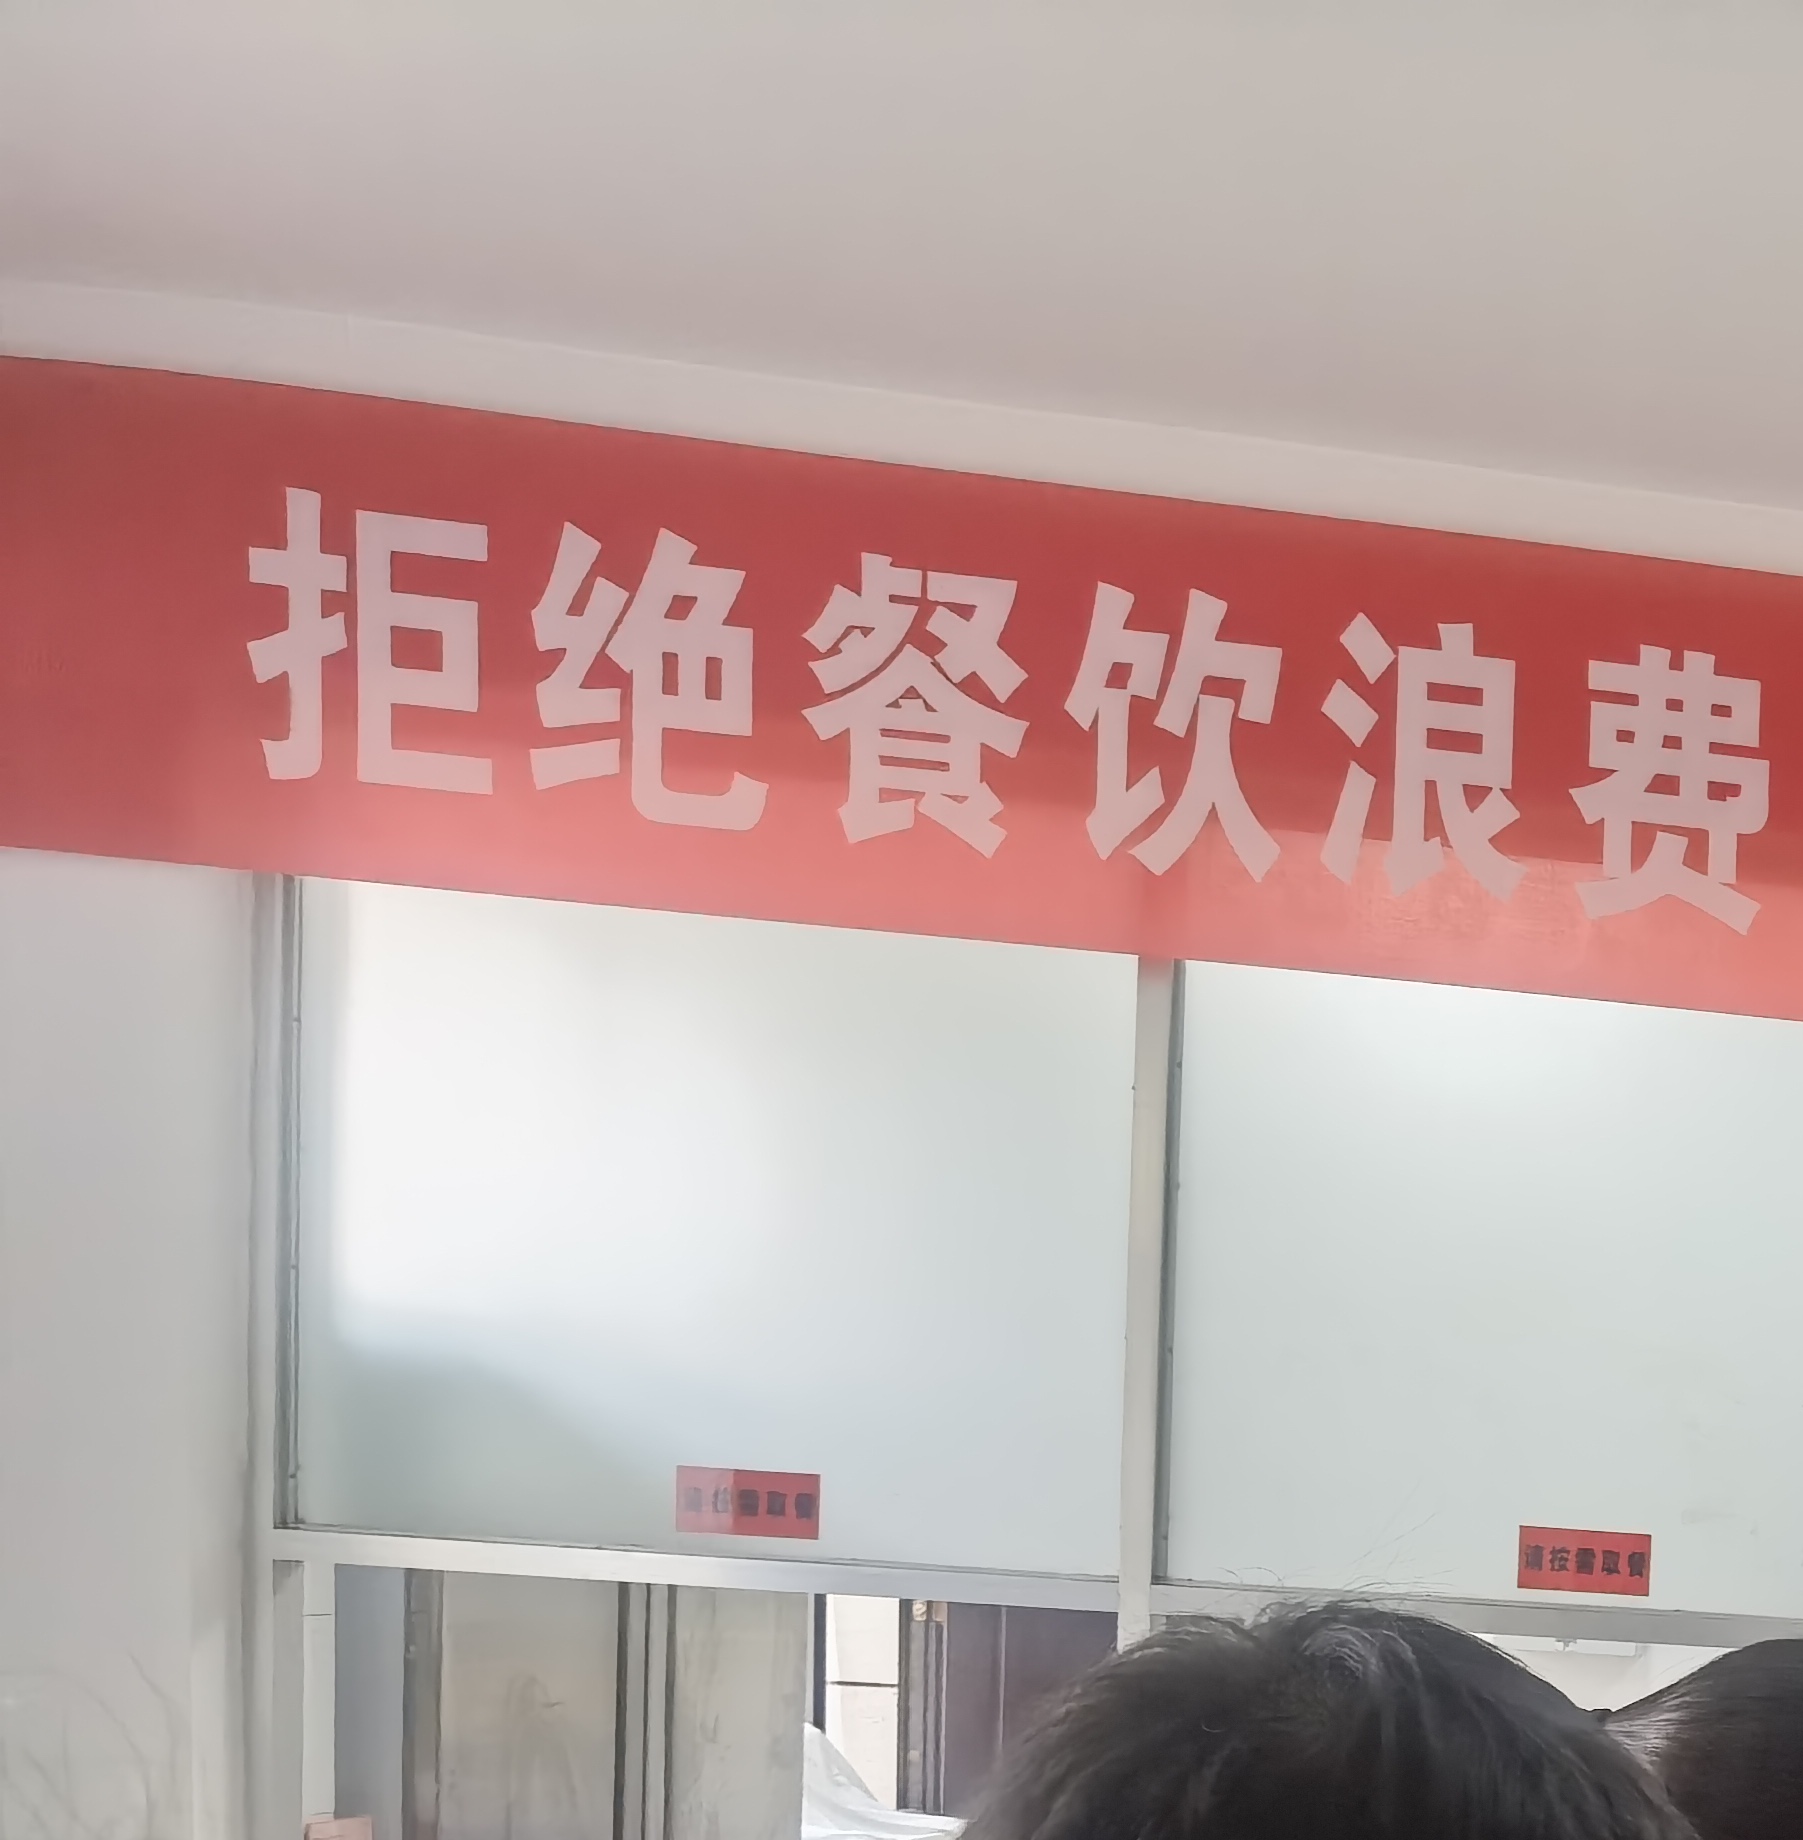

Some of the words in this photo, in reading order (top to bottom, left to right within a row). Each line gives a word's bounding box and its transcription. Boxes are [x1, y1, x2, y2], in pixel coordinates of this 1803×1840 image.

[245, 487, 1772, 936] 拒绝餐饮浪费
